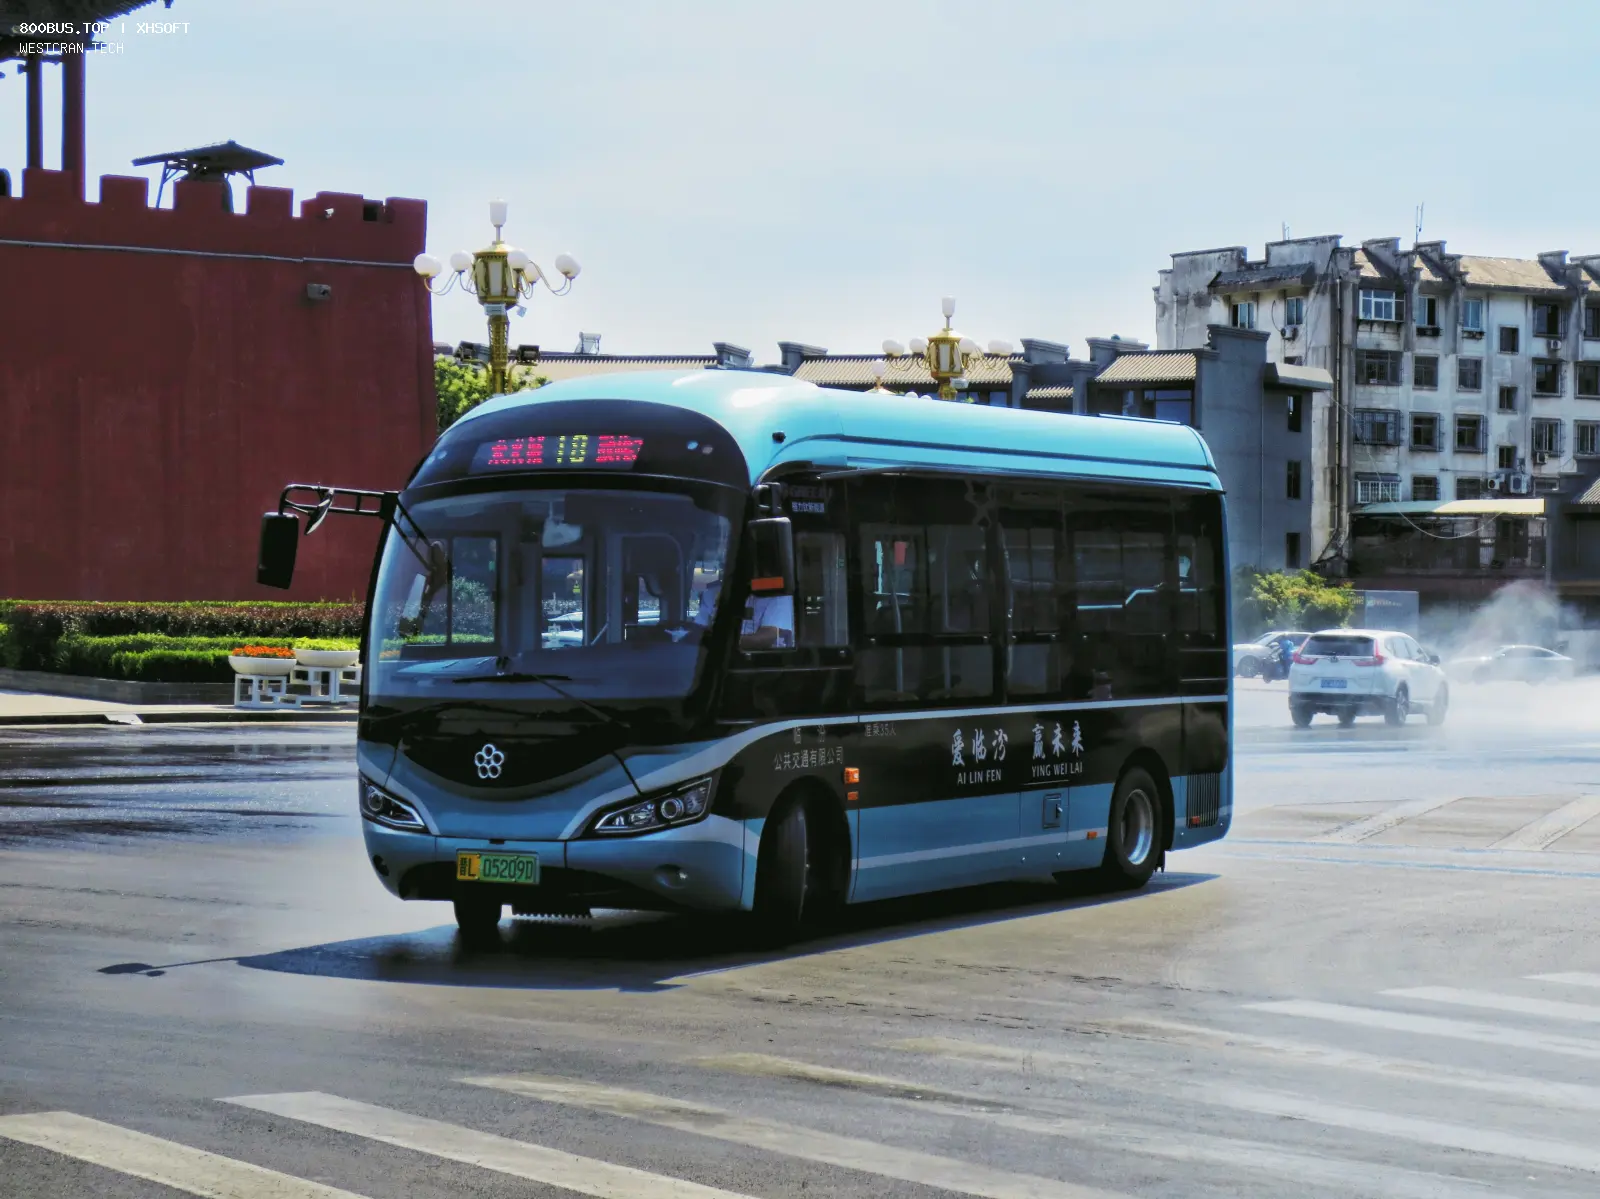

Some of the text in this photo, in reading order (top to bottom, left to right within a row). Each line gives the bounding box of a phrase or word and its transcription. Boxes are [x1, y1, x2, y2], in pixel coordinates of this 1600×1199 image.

[556, 434, 589, 464] 10
[952, 720, 1084, 766] 爱临汾 赢未来
[774, 746, 844, 771] 公共交通有限公司
[1032, 762, 1083, 777] YING WEI LAI
[957, 769, 1002, 785] AI LIN FEN
